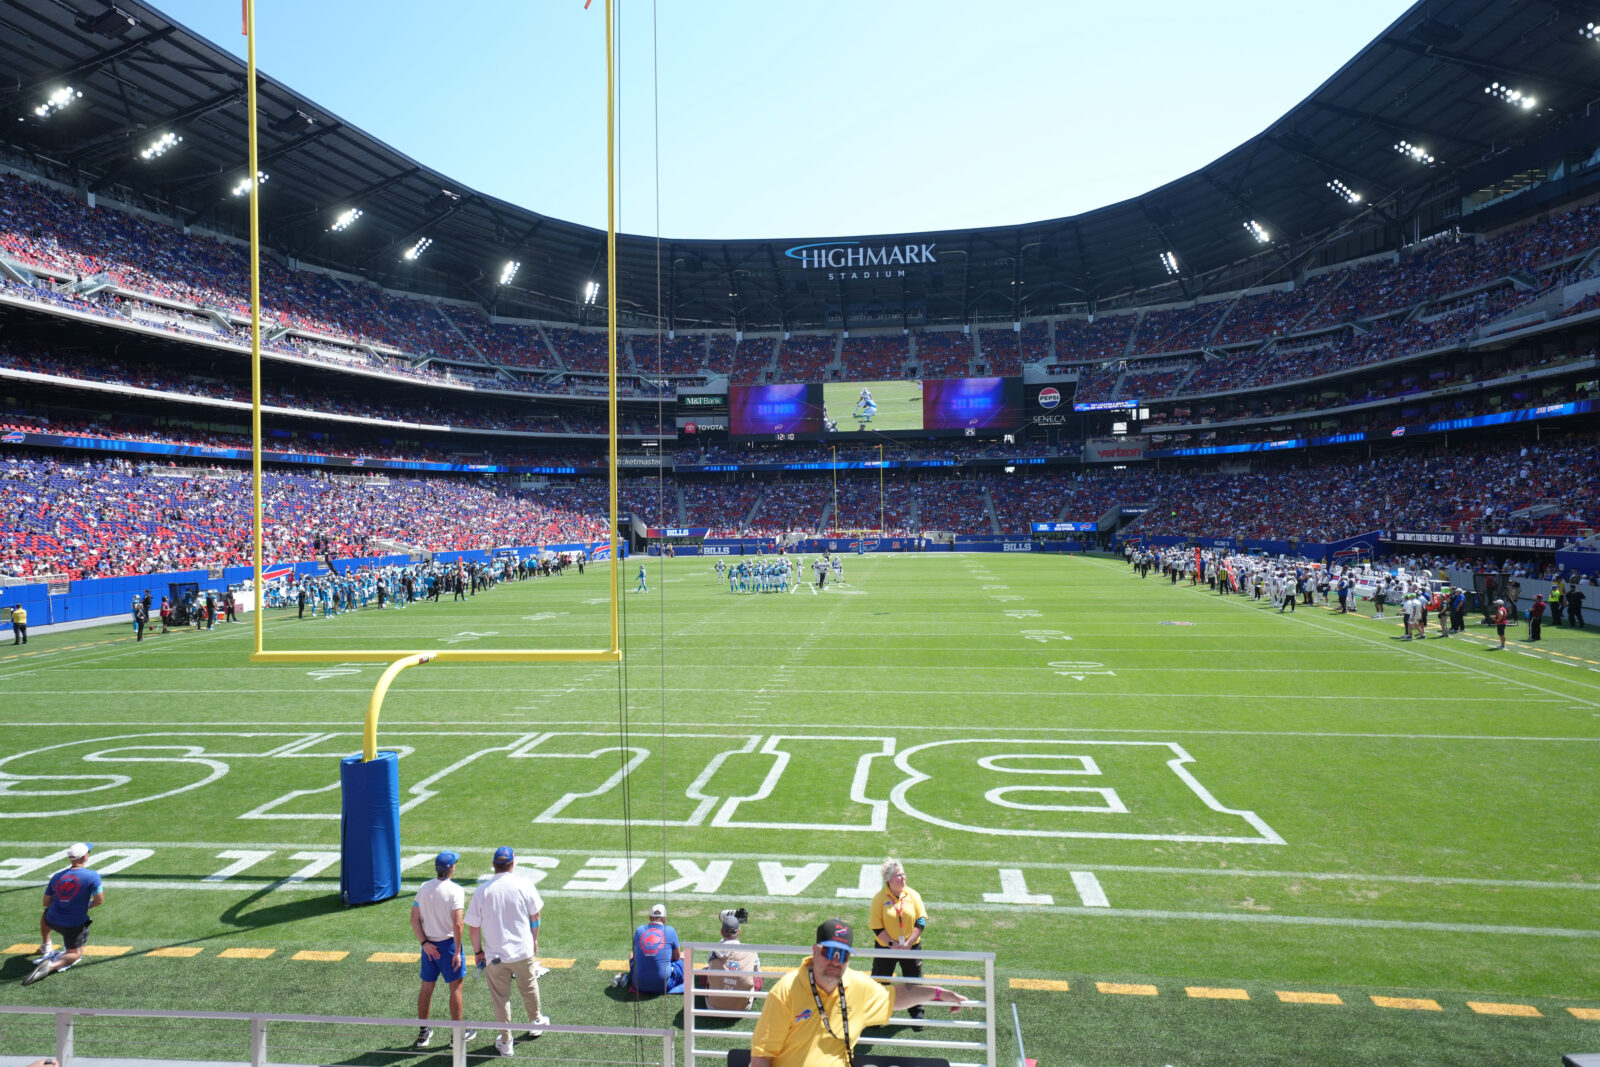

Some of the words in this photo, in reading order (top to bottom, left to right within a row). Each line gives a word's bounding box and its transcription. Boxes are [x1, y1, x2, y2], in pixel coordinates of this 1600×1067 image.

[802, 243, 937, 269] HIGHMARK
[828, 270, 905, 281] STADIUM
[1033, 415, 1066, 424] SENECA
[1097, 447, 1141, 458] verizon
[616, 458, 661, 466] ticketmaster
[1003, 543, 1032, 551] BILLS
[1526, 538, 1535, 547] FREE
[1546, 539, 1556, 548] PLAY
[0, 732, 1286, 846] BILLS
